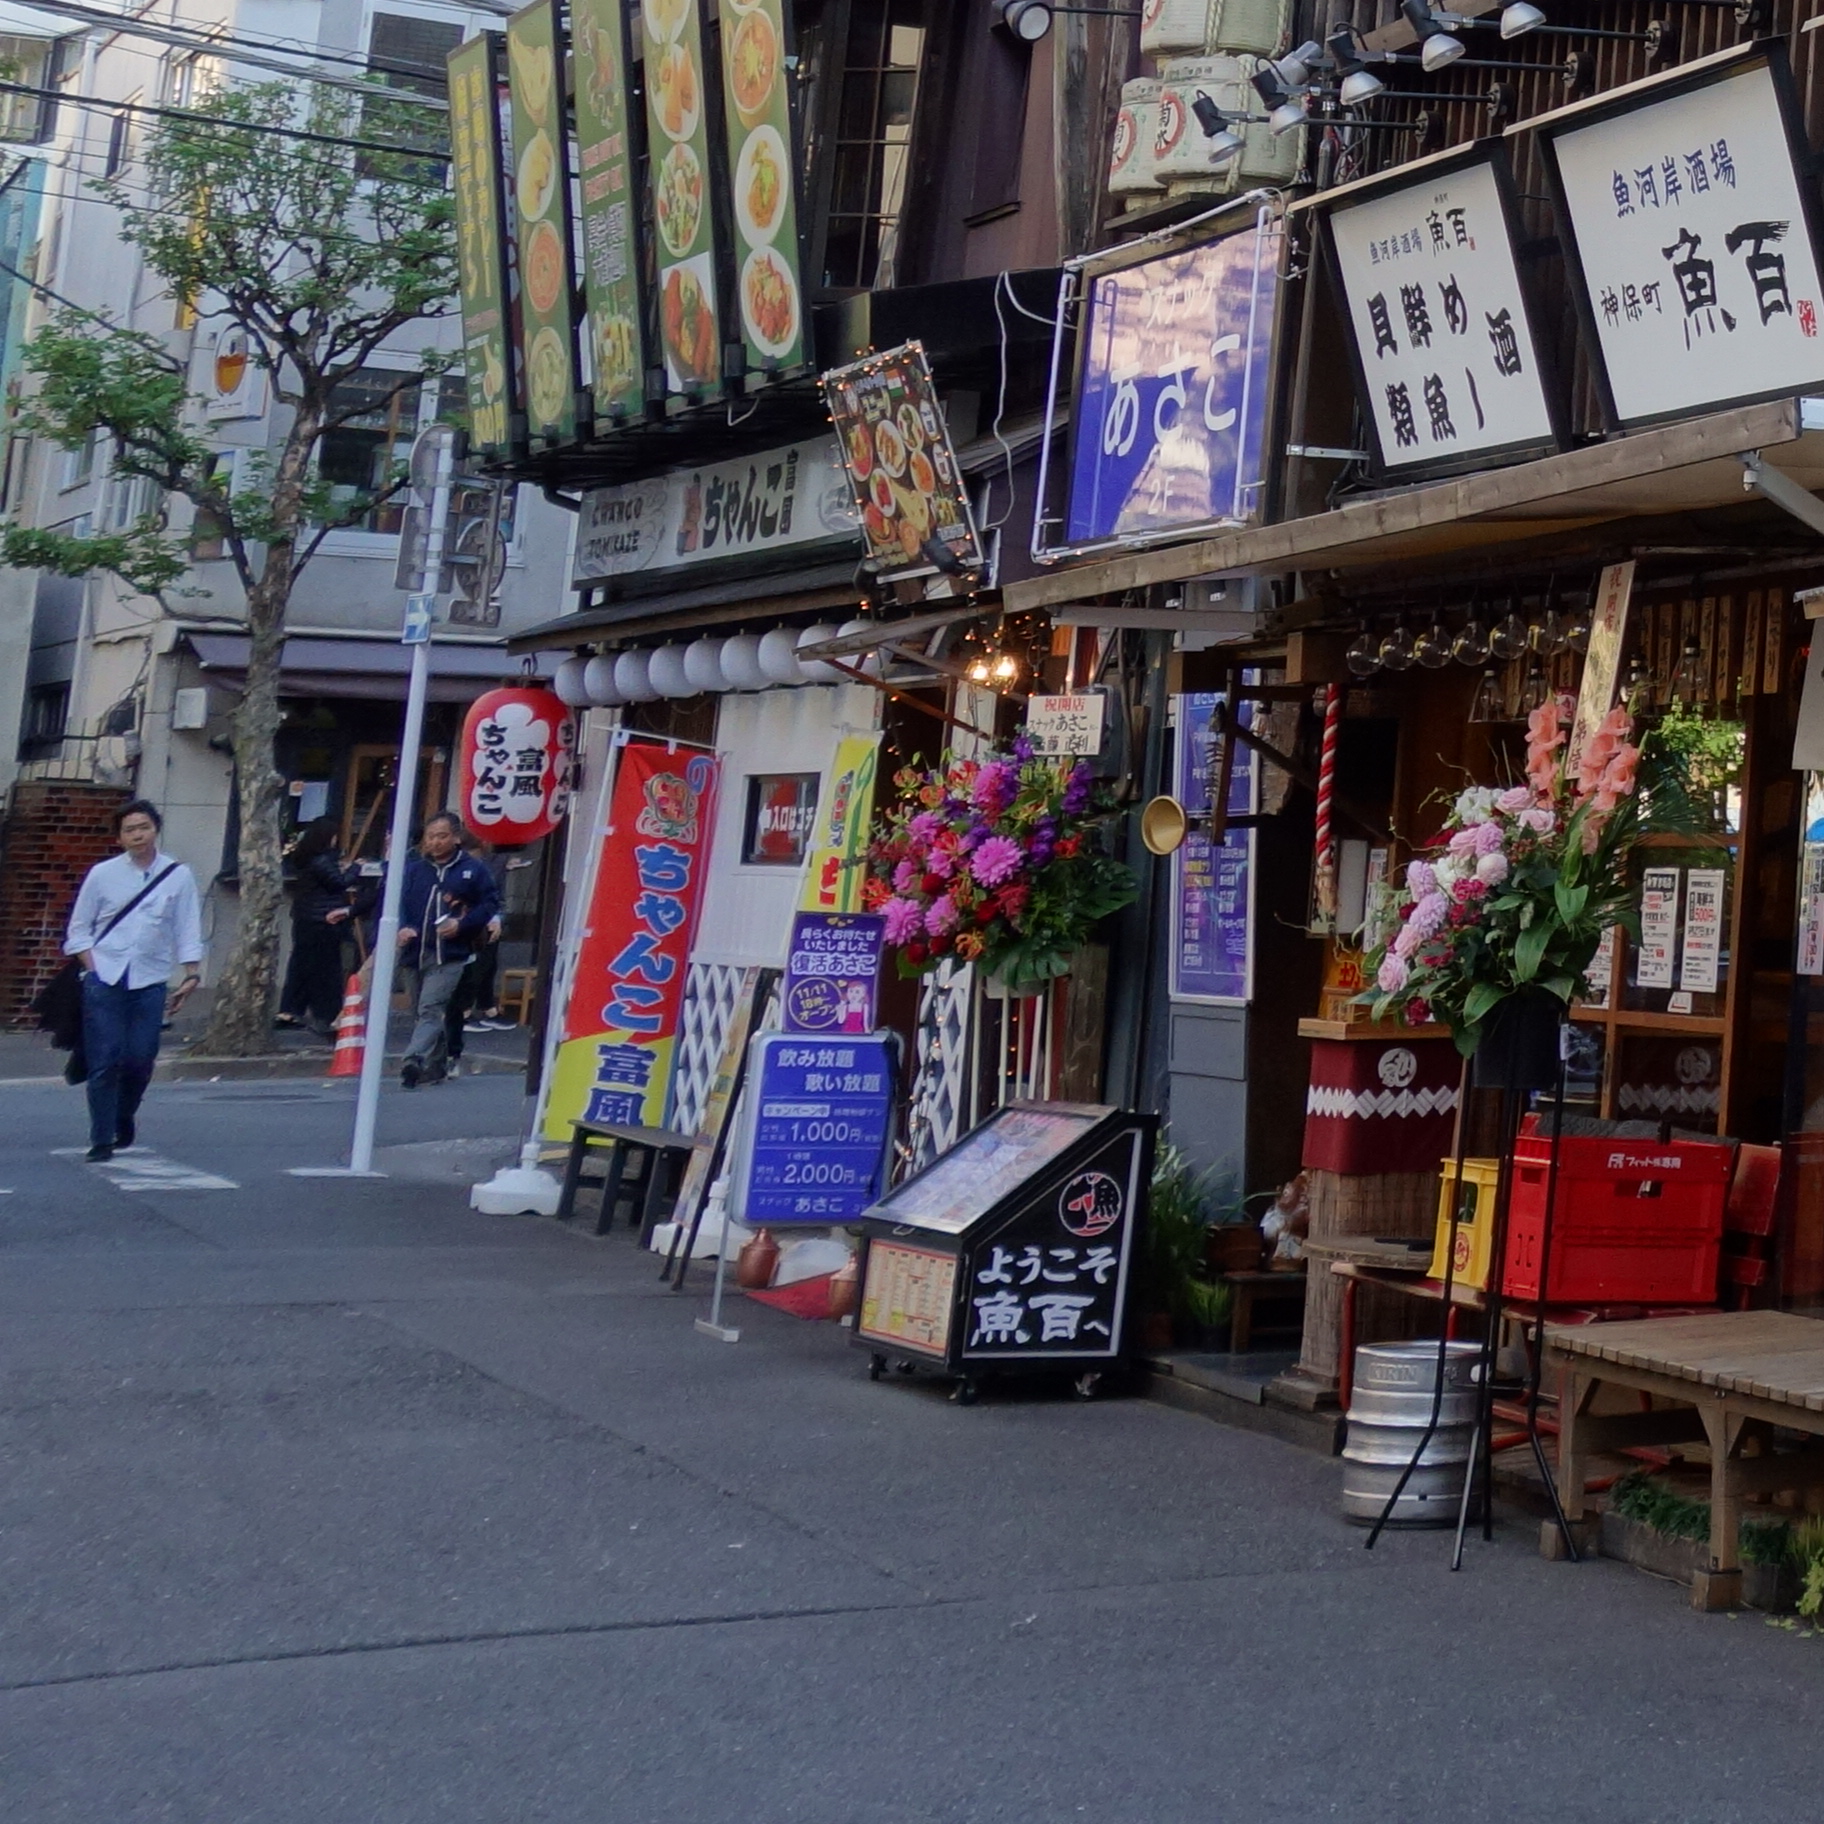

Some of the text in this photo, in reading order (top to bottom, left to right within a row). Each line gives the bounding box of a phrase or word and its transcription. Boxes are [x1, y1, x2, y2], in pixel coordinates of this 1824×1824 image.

[1612, 138, 1736, 218] 魚河岸酒場
[1425, 207, 1468, 258] 魚百
[1147, 271, 1216, 329] スナック
[1600, 281, 1662, 327] 神保町
[1662, 220, 1792, 351] 魚百
[1485, 307, 1522, 377] 酒
[1104, 334, 1240, 457] あさこ
[1148, 475, 1175, 516] 2F
[476, 723, 509, 817] ちゃんこ
[509, 747, 544, 798] 富風
[791, 952, 877, 976] 復活あさこ
[777, 1048, 856, 1068] 飲み放題
[805, 1073, 882, 1093] 歌い放題
[794, 1197, 844, 1214] あさこ
[976, 1245, 1117, 1285] ようこそ
